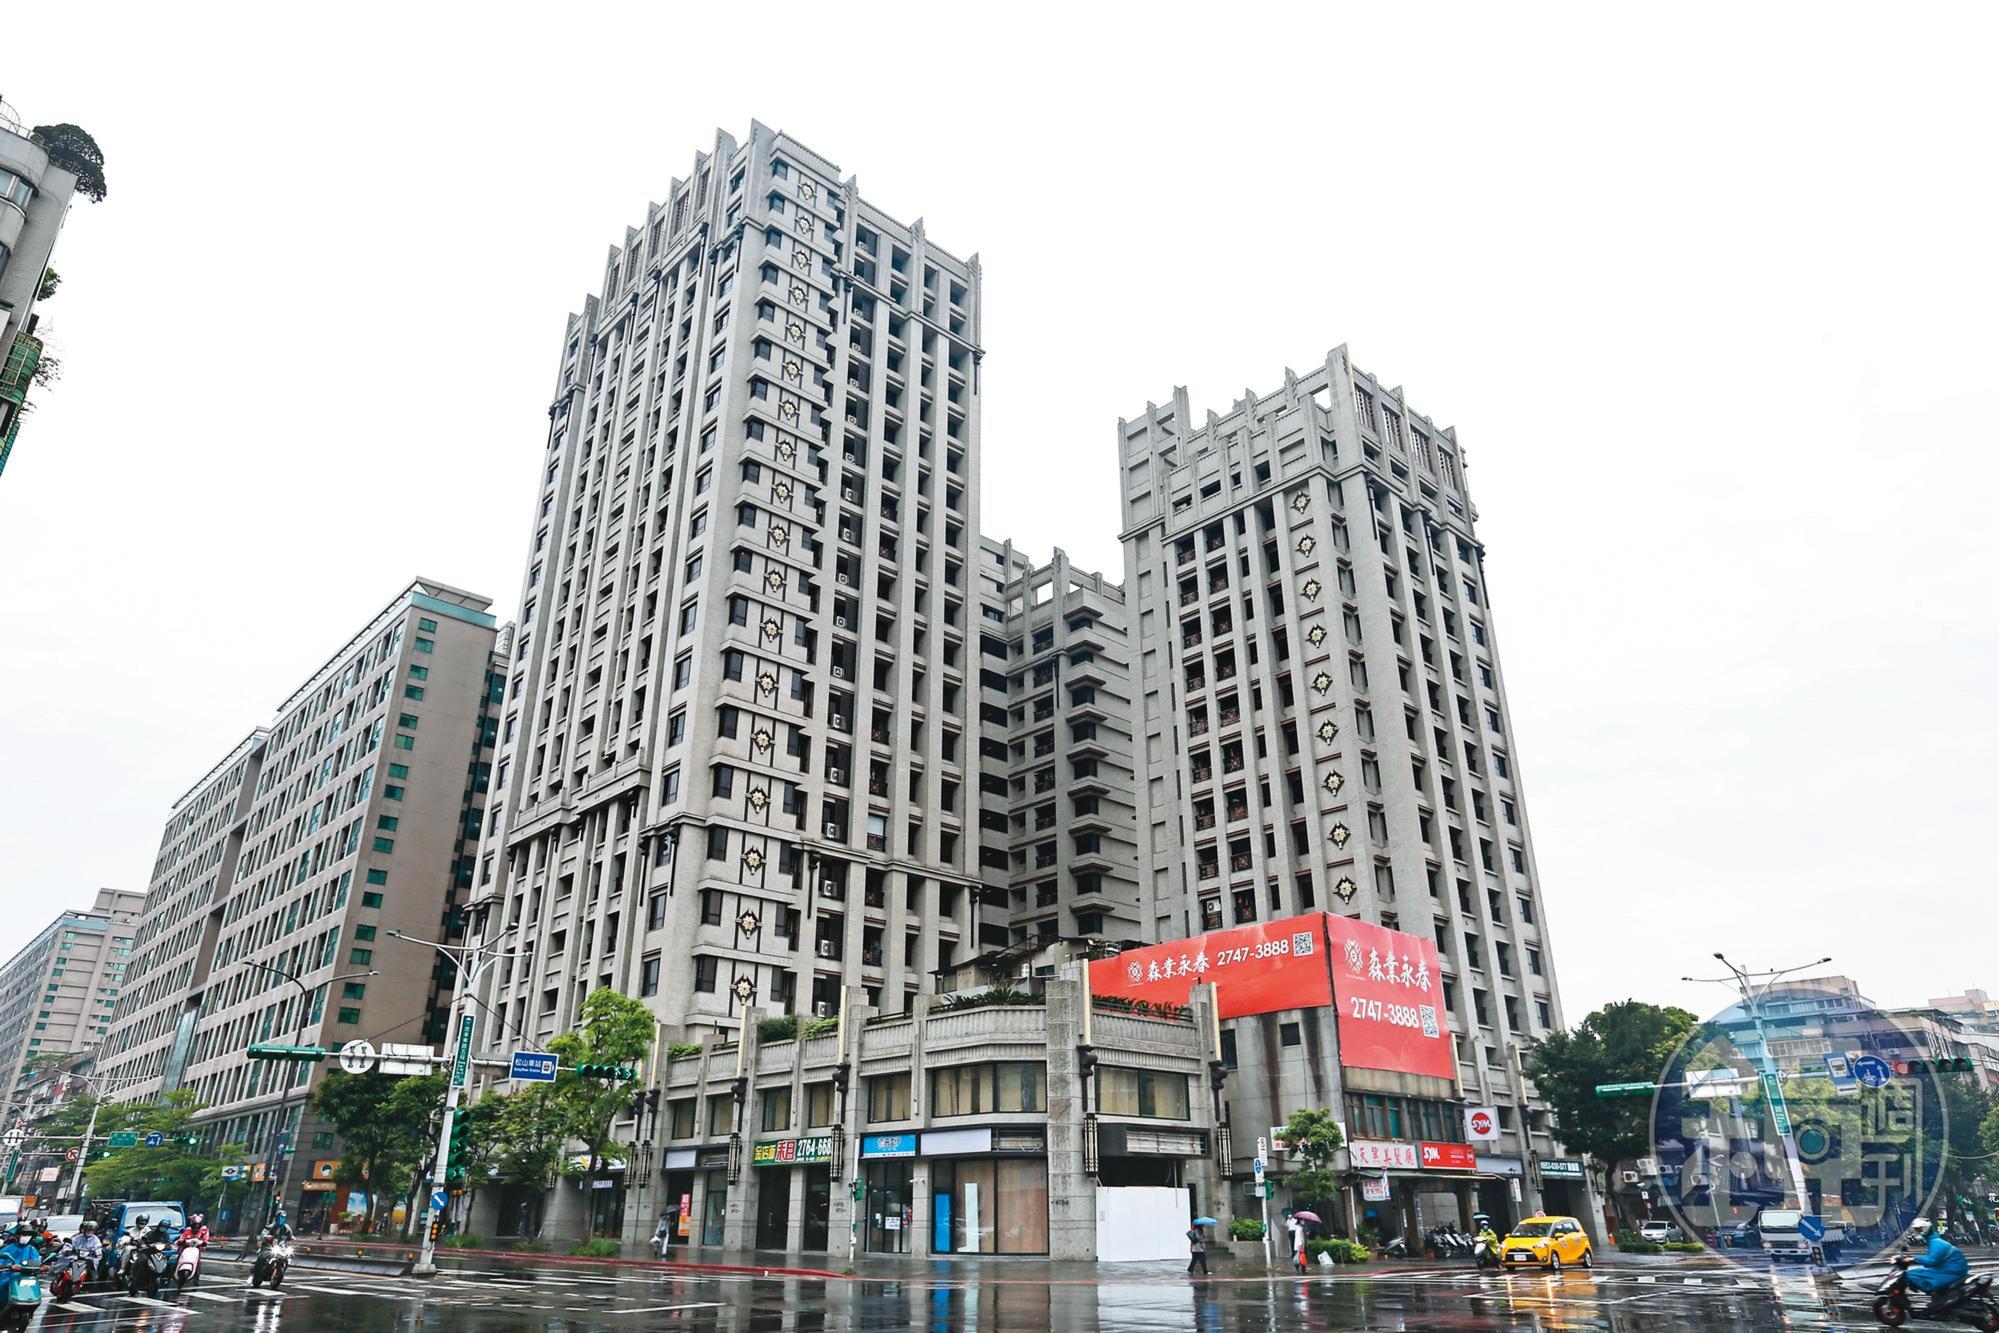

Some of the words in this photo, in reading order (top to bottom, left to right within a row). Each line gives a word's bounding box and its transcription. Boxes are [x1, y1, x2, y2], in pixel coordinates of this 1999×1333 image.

[1147, 951, 1210, 982] 森業永春
[1217, 939, 1289, 967] 2747-3888
[1368, 947, 1432, 992] 森業永春
[1350, 996, 1419, 1028] 2747-3888
[1472, 1119, 1492, 1131] SYM
[775, 1139, 797, 1163] 租
[797, 1138, 832, 1157] 2764-668
[1423, 1146, 1441, 1162] SYM
